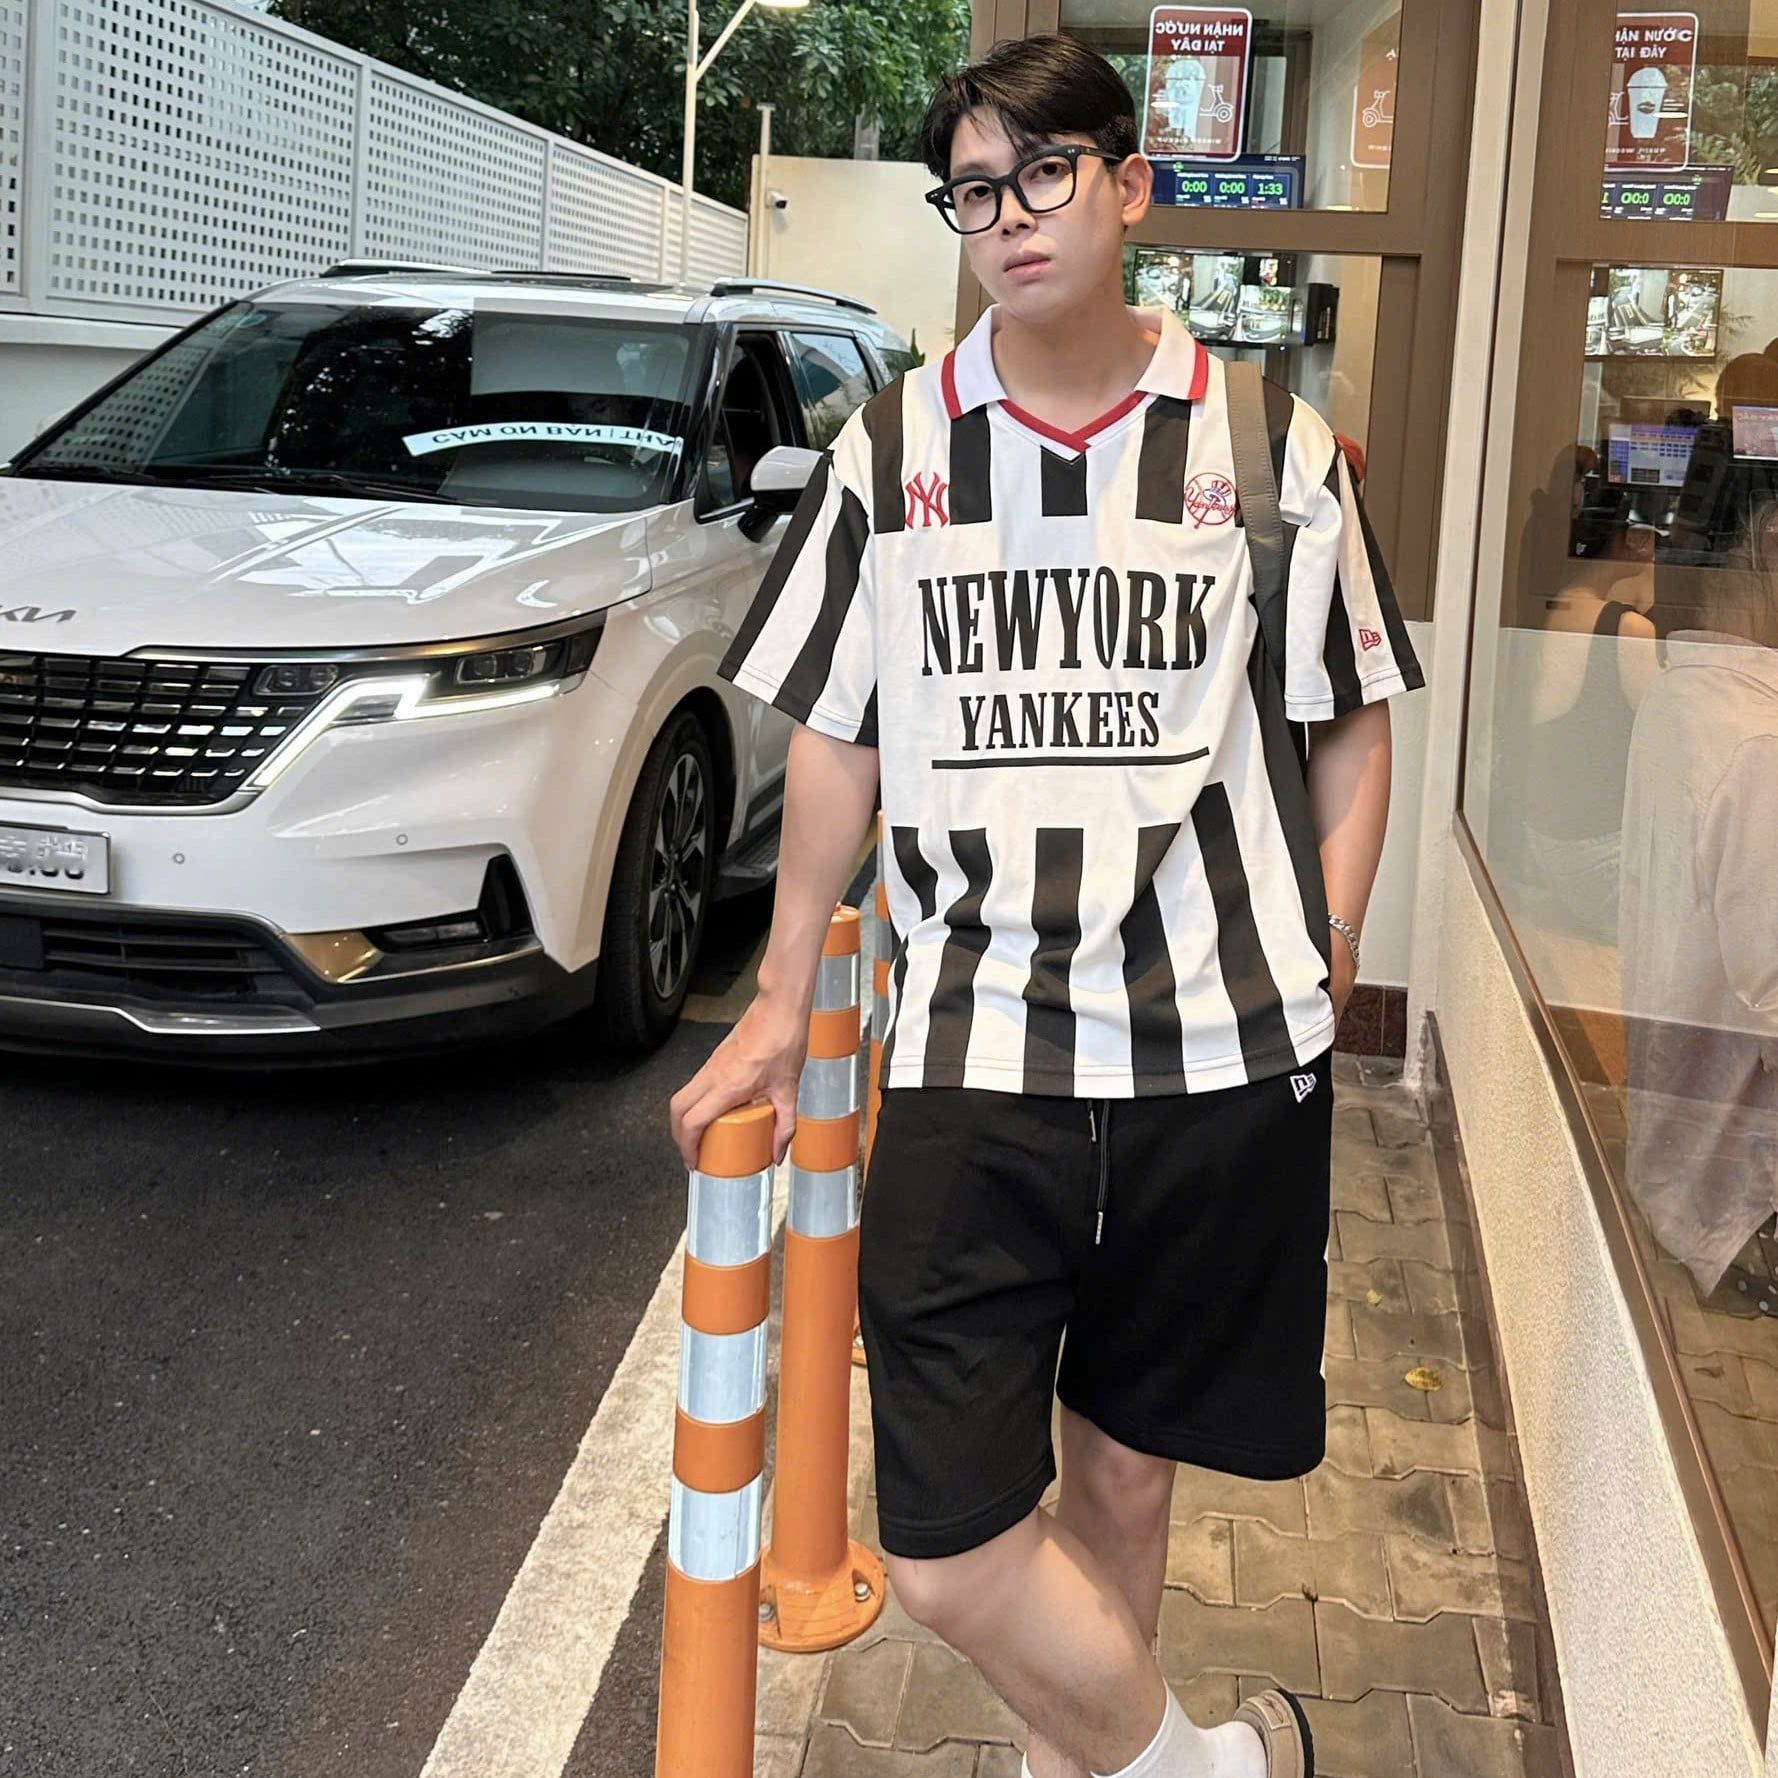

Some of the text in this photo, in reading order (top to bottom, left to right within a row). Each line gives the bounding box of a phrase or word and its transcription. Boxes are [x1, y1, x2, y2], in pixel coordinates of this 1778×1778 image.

[1644, 26, 1693, 42] NƯỚC
[1614, 47, 1634, 61] TẠI
[1182, 180, 1284, 196] 0:00 0:00 1:33
[959, 691, 1160, 751] YANKEES
